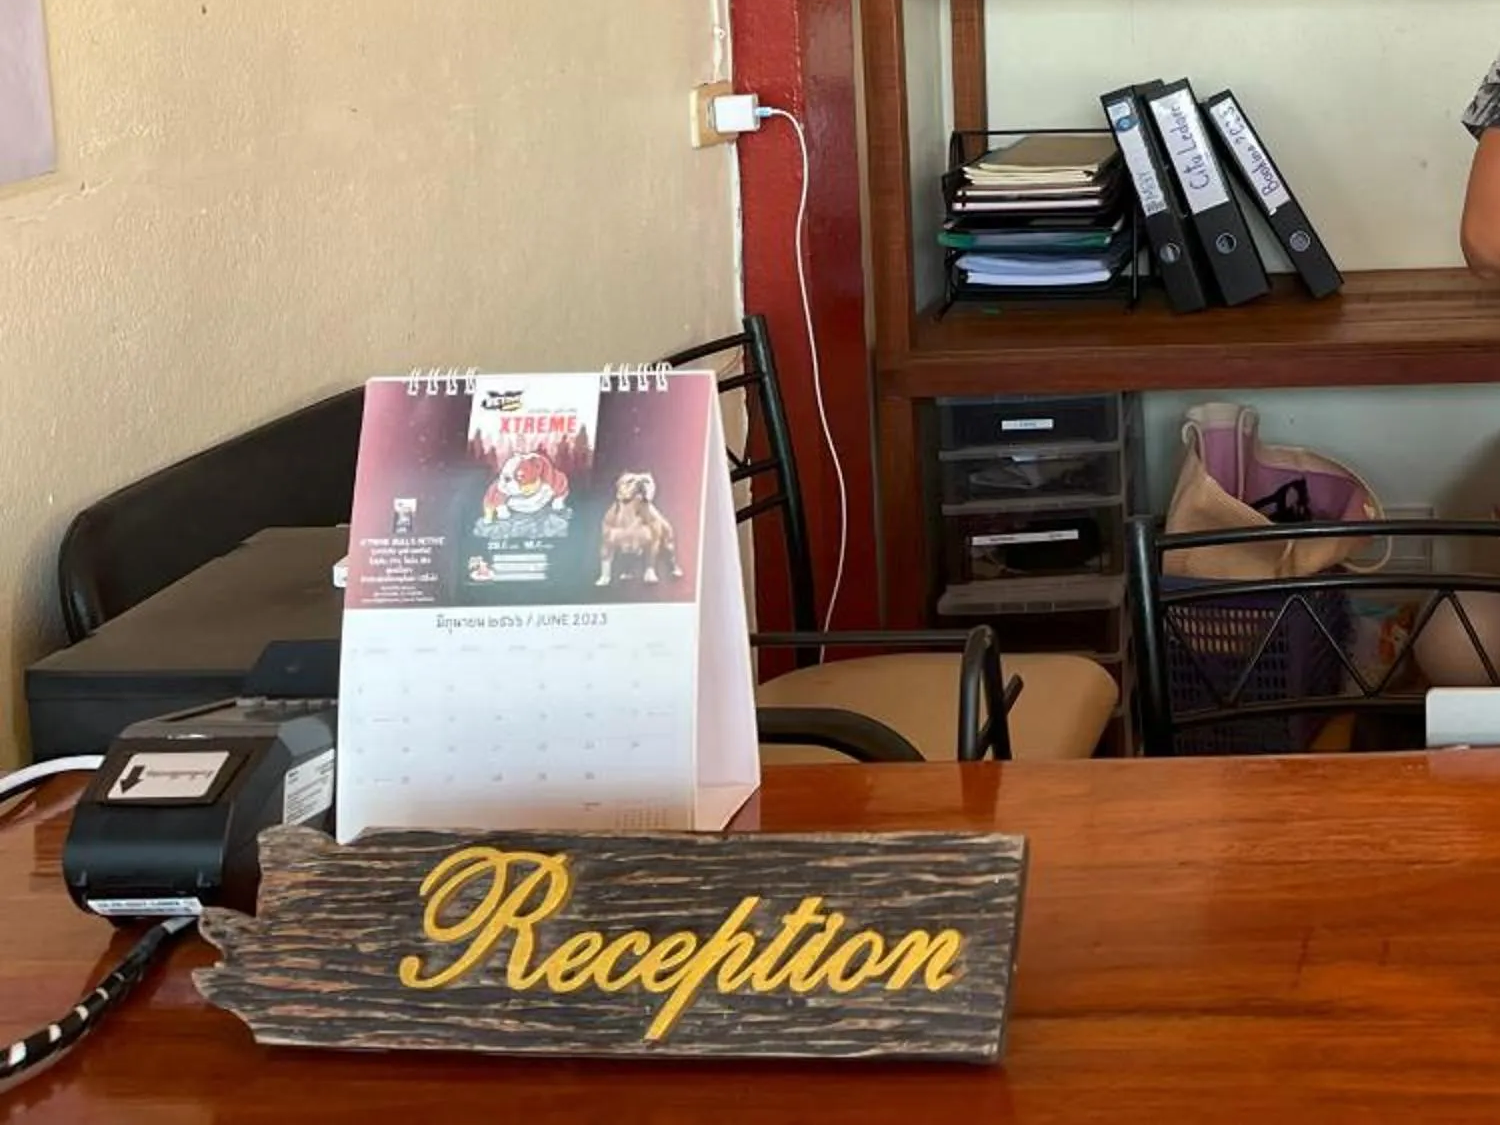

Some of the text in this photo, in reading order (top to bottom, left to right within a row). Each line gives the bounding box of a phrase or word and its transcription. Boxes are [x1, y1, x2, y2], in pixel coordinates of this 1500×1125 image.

[499, 415, 577, 434] XTREME
[536, 613, 569, 627] JUNE
[572, 611, 608, 627] 2023
[399, 845, 965, 1044] Reception
